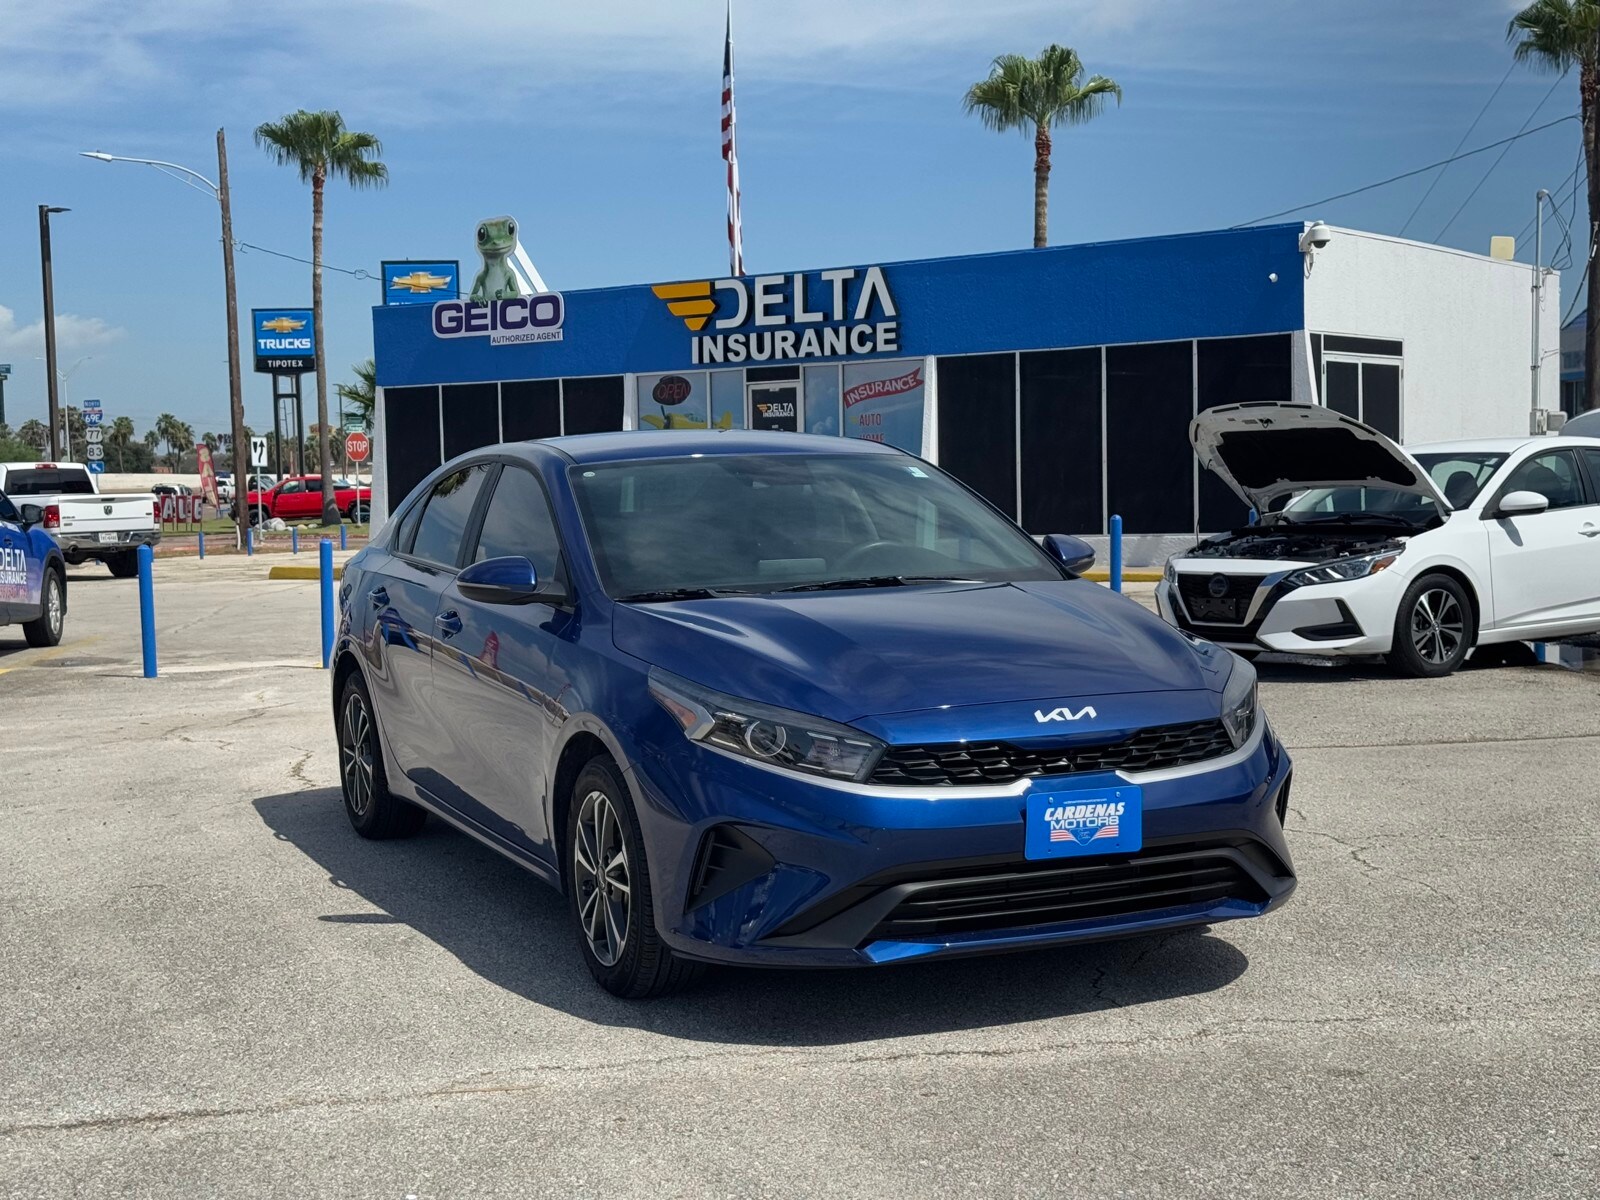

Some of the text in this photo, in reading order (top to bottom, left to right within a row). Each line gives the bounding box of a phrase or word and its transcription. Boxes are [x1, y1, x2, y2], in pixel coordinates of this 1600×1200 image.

[714, 266, 897, 330] DELTA
[435, 295, 561, 335] GEICO
[258, 338, 311, 350] TRUCKS
[491, 331, 561, 345] AUTHORIZED AGENT
[691, 321, 898, 364] INSURANCE
[267, 359, 304, 368] TIPOTEX
[657, 382, 690, 400] OPEN
[846, 374, 917, 405] INSURANCE
[762, 410, 795, 418] INSURANCE
[766, 402, 794, 413] DELTA
[85, 414, 101, 423] 69E
[859, 413, 882, 427] AUTO
[87, 429, 101, 440] 77
[88, 446, 103, 457] 83
[347, 440, 368, 453] STOP
[162, 497, 203, 520] ALE
[0, 547, 27, 572] DELTA
[0, 571, 27, 585] SURANCE
[1033, 705, 1098, 723] KIA
[1044, 802, 1125, 821] CARDENAS
[1050, 815, 1120, 830] MOTORS
